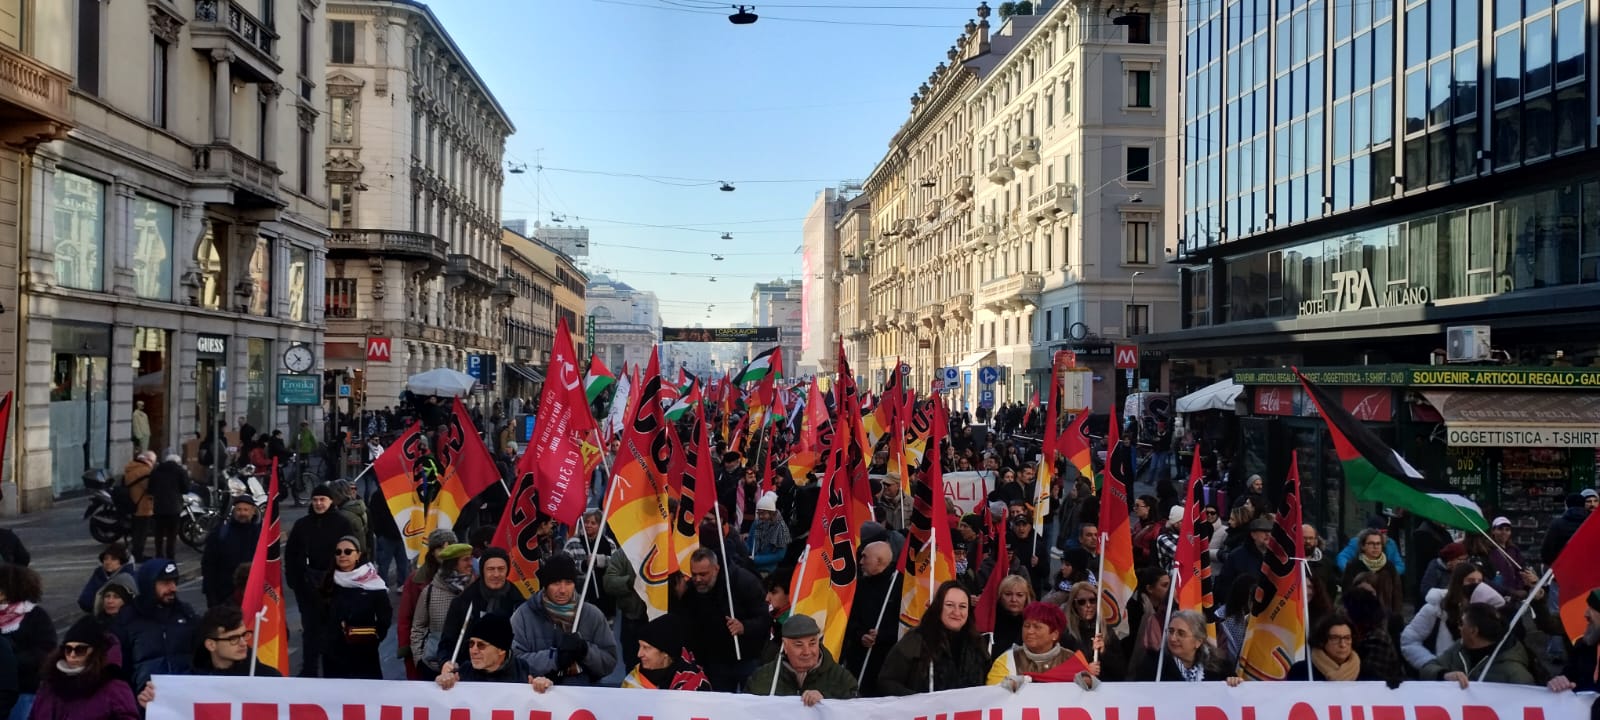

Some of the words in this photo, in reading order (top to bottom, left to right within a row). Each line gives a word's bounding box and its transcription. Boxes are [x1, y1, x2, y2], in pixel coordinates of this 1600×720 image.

[1298, 300, 1329, 315] HOTEL
[1383, 286, 1428, 307] MILANO
[197, 337, 224, 353] GUESS
[368, 341, 389, 357] M
[470, 356, 481, 368] P
[1117, 349, 1137, 364] M
[1364, 372, 1387, 383] T-SHIRT
[1391, 372, 1404, 383] DVD
[1413, 371, 1470, 384] SOUVENIR
[1475, 372, 1526, 384] ARTICOLI
[1529, 373, 1574, 385] REGALO
[984, 391, 992, 401] P
[1460, 409, 1529, 418] CORRIERE
[1450, 431, 1542, 443] OGGETTISTICA
[1552, 432, 1599, 445] T-SHIRT
[1457, 459, 1474, 470] DVD
